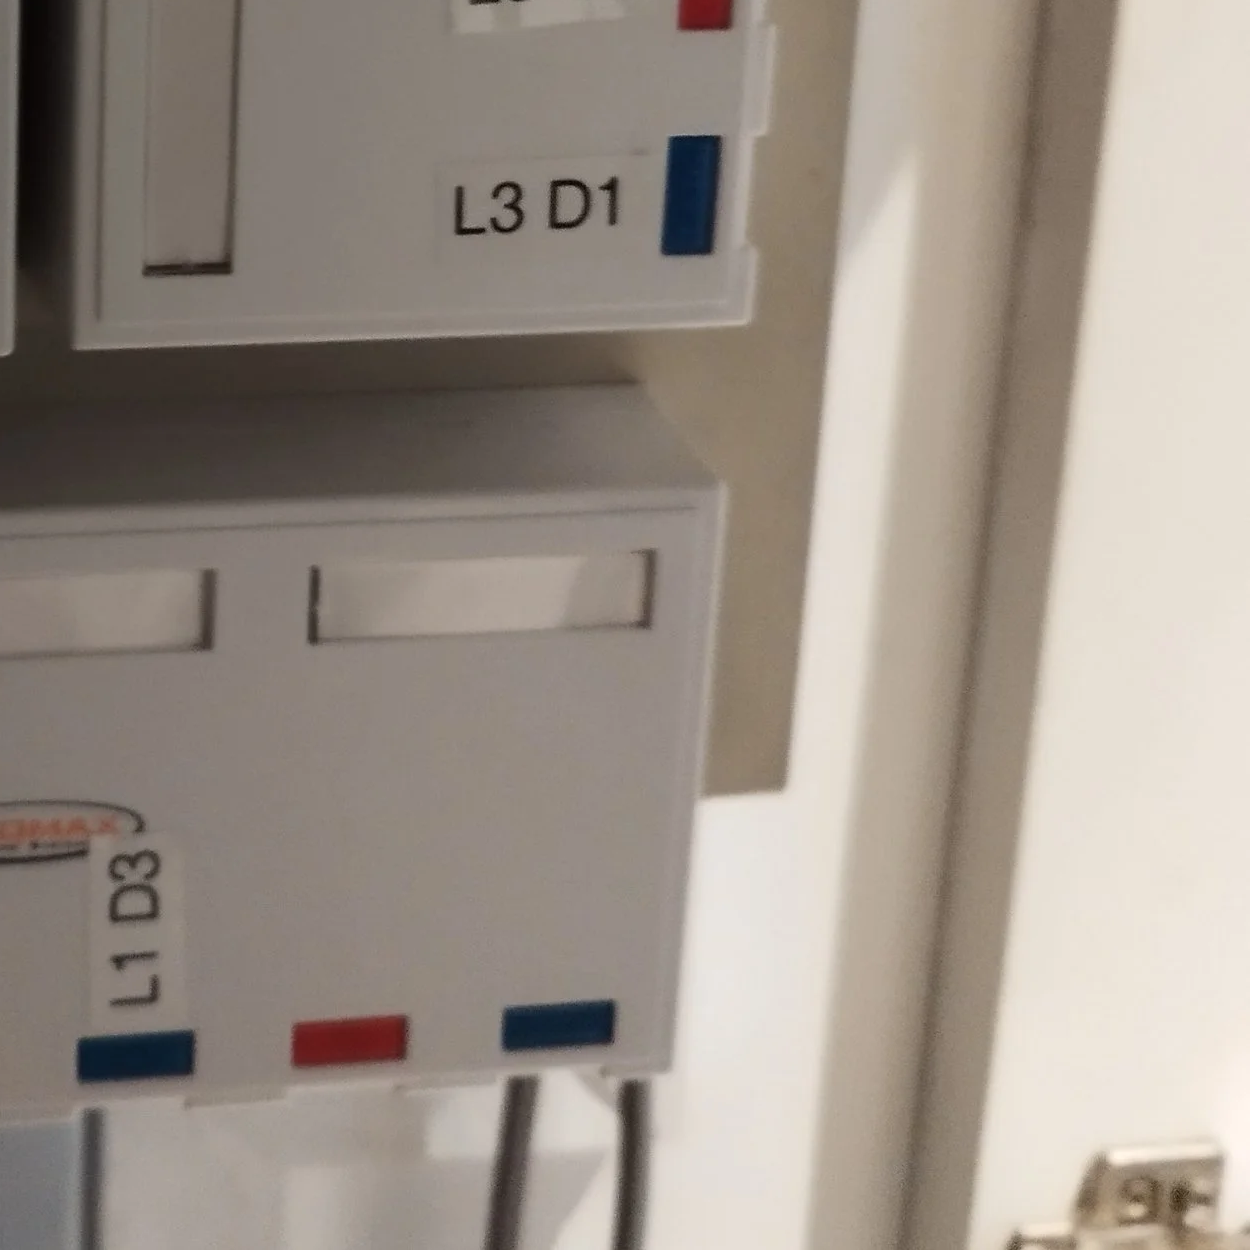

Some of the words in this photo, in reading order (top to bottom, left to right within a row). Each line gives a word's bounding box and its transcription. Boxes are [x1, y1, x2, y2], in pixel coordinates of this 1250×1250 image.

[454, 181, 525, 236] L3
[549, 177, 619, 230] D1
[108, 849, 161, 924] D3
[110, 951, 160, 1007] L1
